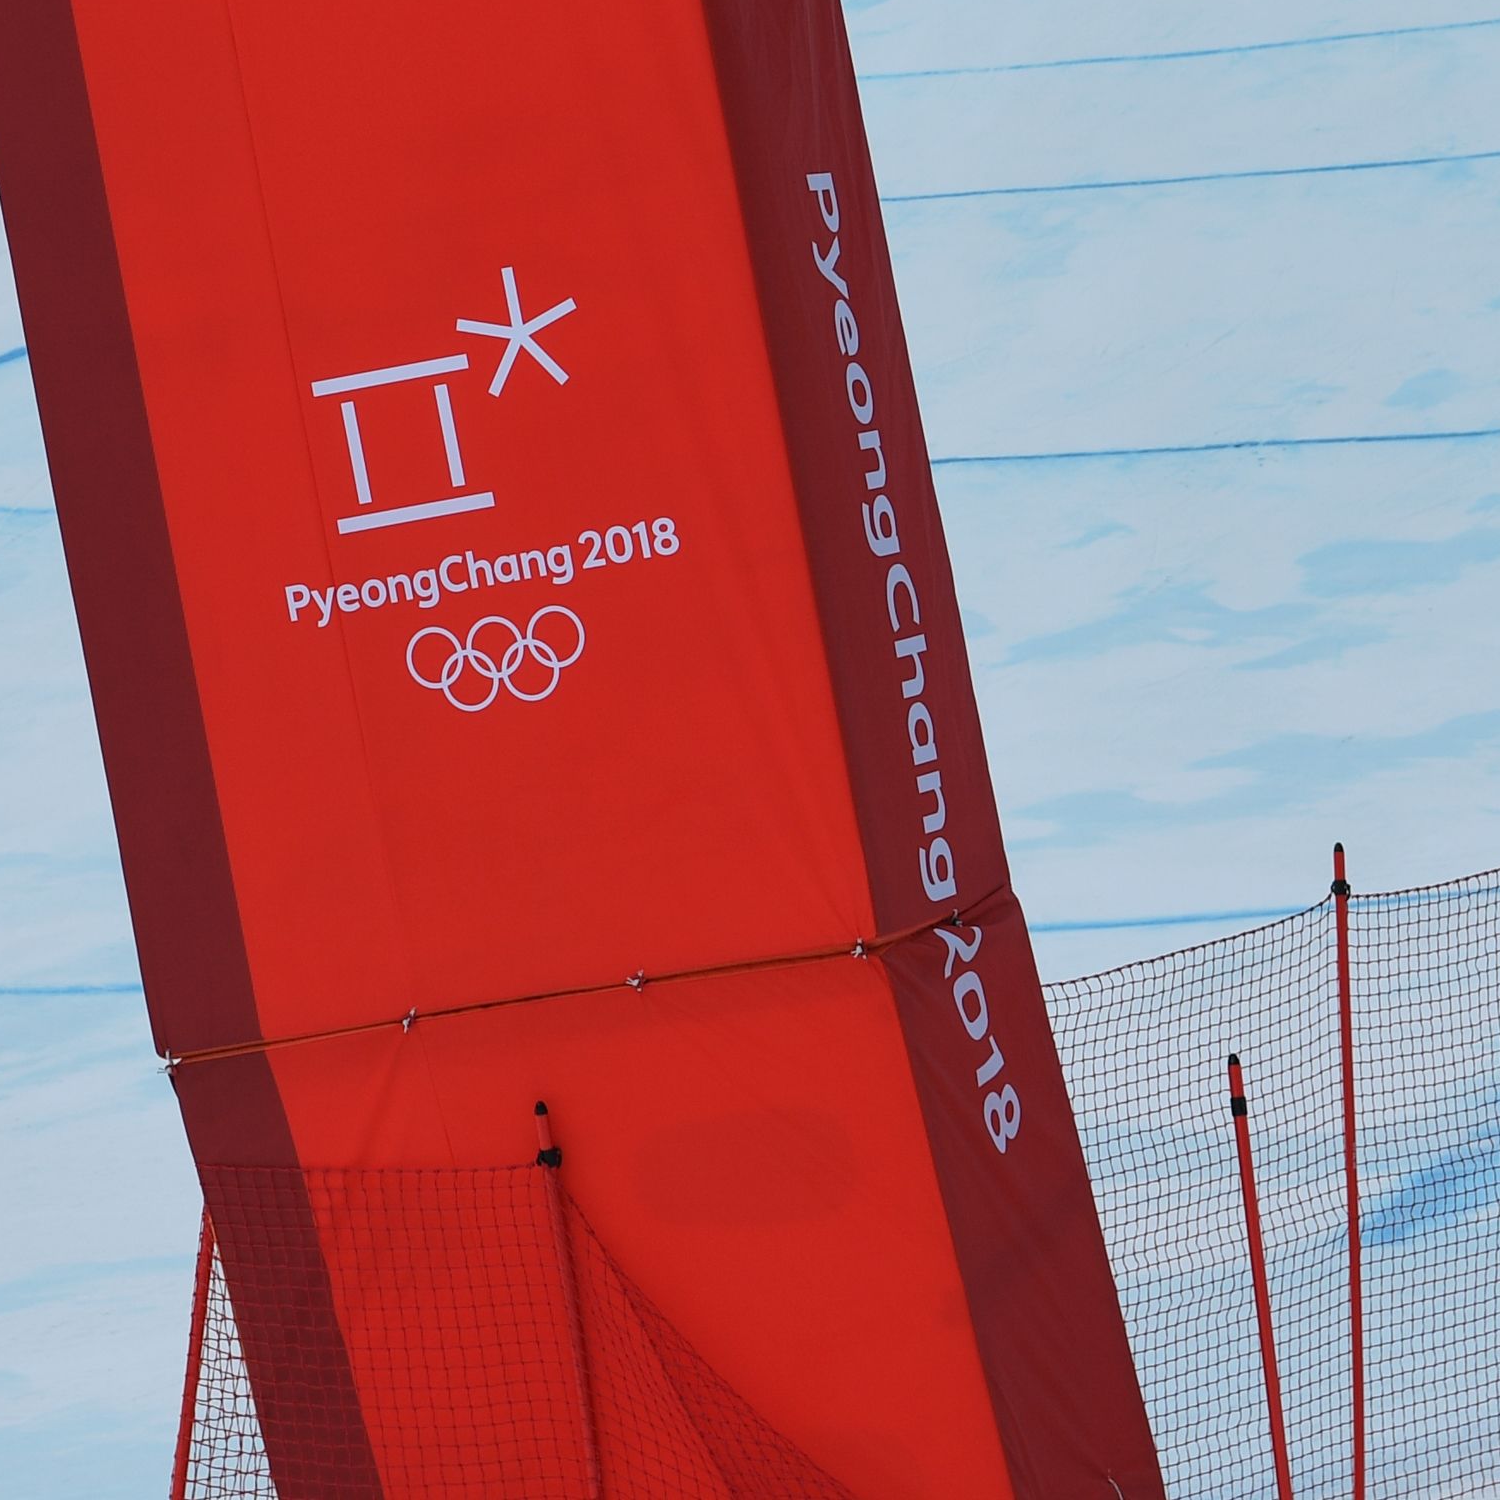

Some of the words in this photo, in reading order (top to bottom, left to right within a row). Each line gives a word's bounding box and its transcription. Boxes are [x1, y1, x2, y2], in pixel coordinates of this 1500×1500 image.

[284, 544, 576, 629] PyeongChang
[577, 516, 681, 570] 2018
[804, 170, 959, 904] PyeongChang
[932, 922, 1022, 1155] 2018
